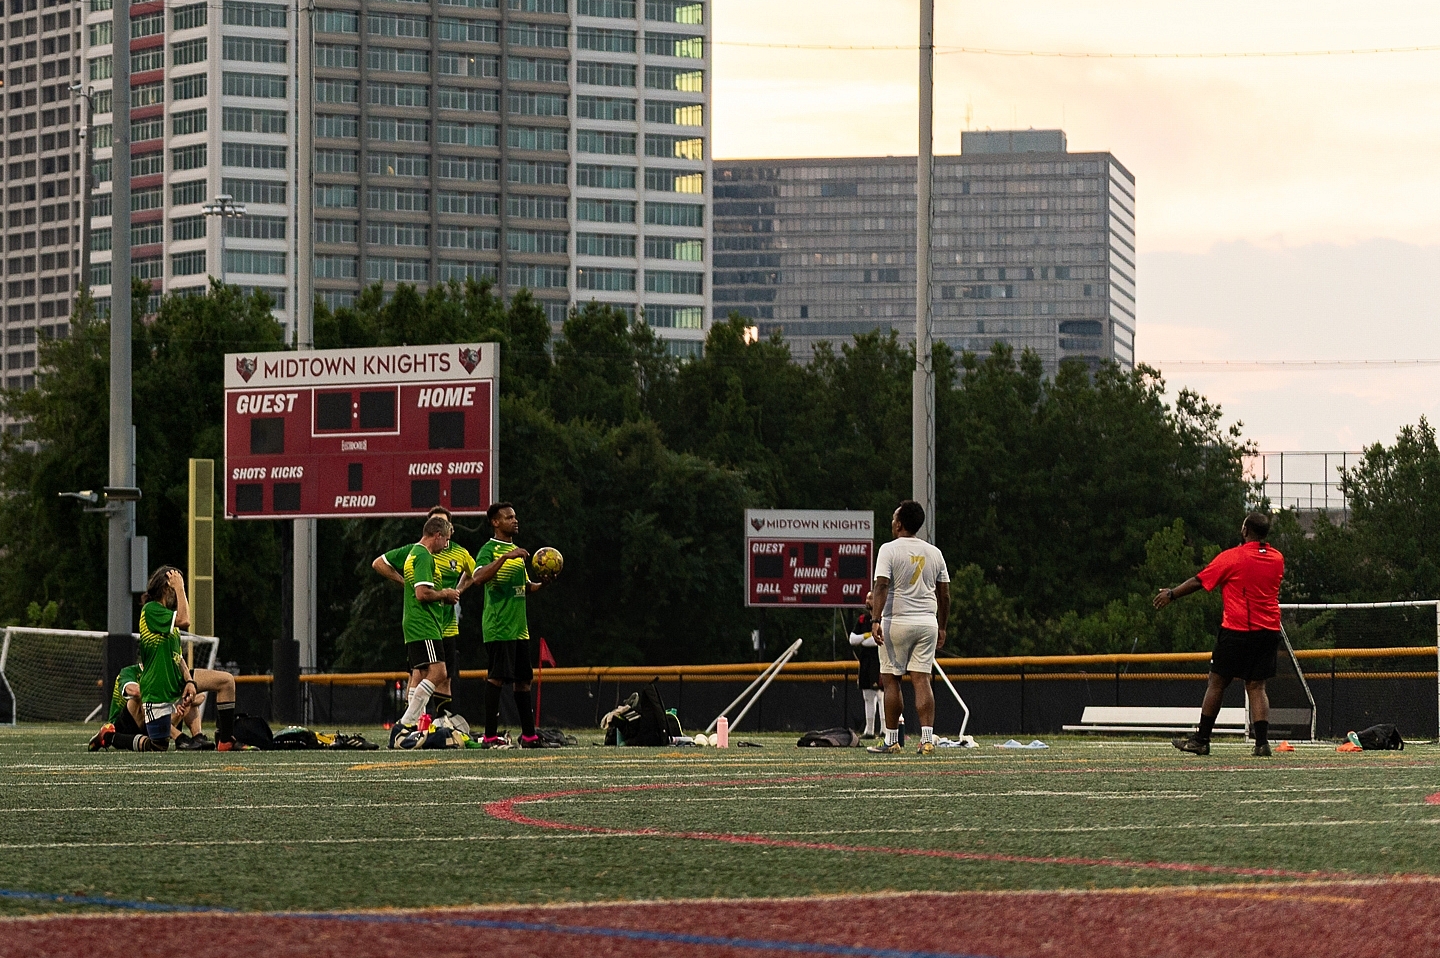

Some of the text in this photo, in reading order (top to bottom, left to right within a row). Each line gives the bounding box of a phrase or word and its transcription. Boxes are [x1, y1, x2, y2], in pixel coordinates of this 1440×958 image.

[264, 352, 451, 378] MIDTOWN KNIGHTS
[417, 387, 476, 408] HOME
[236, 393, 298, 414] GUEST
[232, 466, 304, 480] SHOTS KICKS
[408, 461, 484, 475] KICKS SHOTS
[334, 495, 376, 508] PERIOD
[766, 519, 870, 530] MIDTOWN KNIGHTS
[752, 543, 785, 554] GUEST
[838, 544, 867, 555] HOME
[789, 557, 797, 567] H
[824, 557, 832, 567] E
[793, 568, 828, 578] INNING
[909, 555, 926, 585] 7
[756, 583, 781, 593] BALL
[792, 583, 828, 594] STRIKE
[842, 584, 862, 594] OUT
